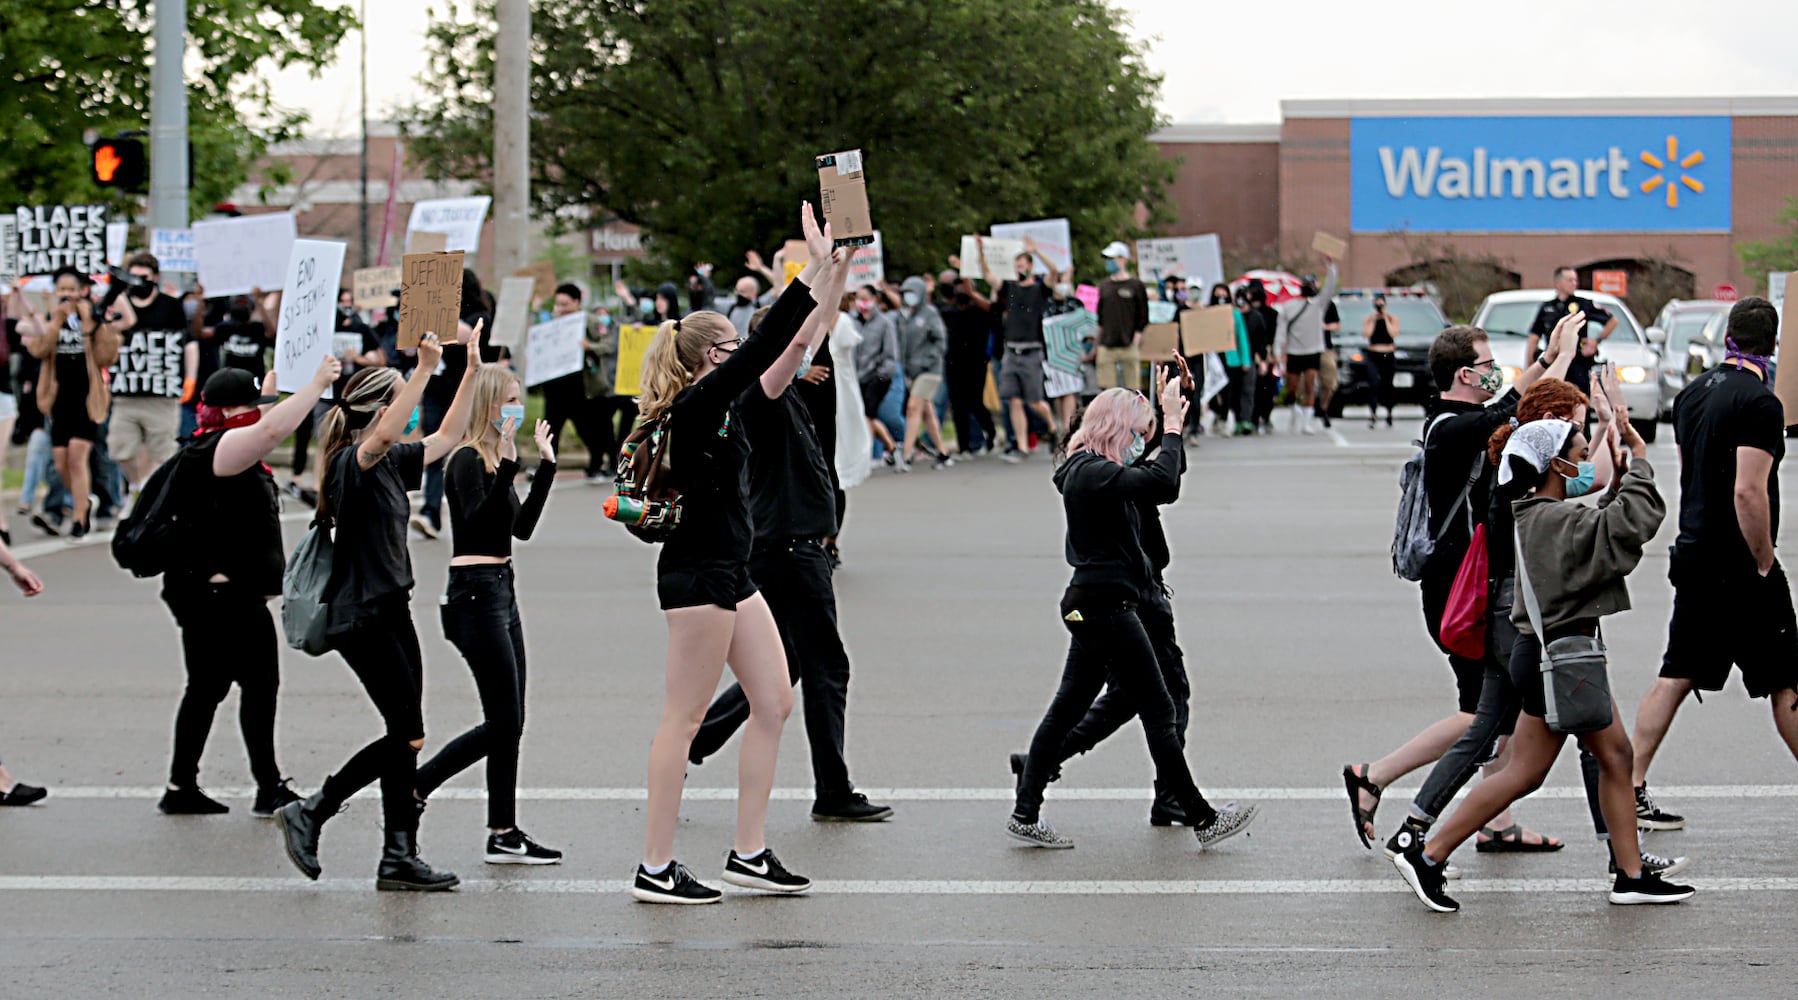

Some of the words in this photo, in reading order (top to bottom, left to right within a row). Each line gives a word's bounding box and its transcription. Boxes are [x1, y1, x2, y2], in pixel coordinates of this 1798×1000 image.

[1378, 146, 1630, 199] Walmart
[16, 205, 106, 233] BLACK
[22, 227, 103, 251] LIVES
[156, 245, 194, 257] LIVE
[157, 231, 193, 243] BLAC
[17, 248, 109, 276] MATTER
[297, 257, 315, 288] END
[411, 259, 461, 287] DEFUND
[284, 279, 326, 331] SYSTEMIC
[427, 289, 442, 304] THE
[410, 307, 458, 341] POLICE
[117, 331, 184, 354] ACK
[284, 322, 319, 370] RACISM
[108, 353, 181, 376] IVES
[109, 371, 185, 398] ATTER
